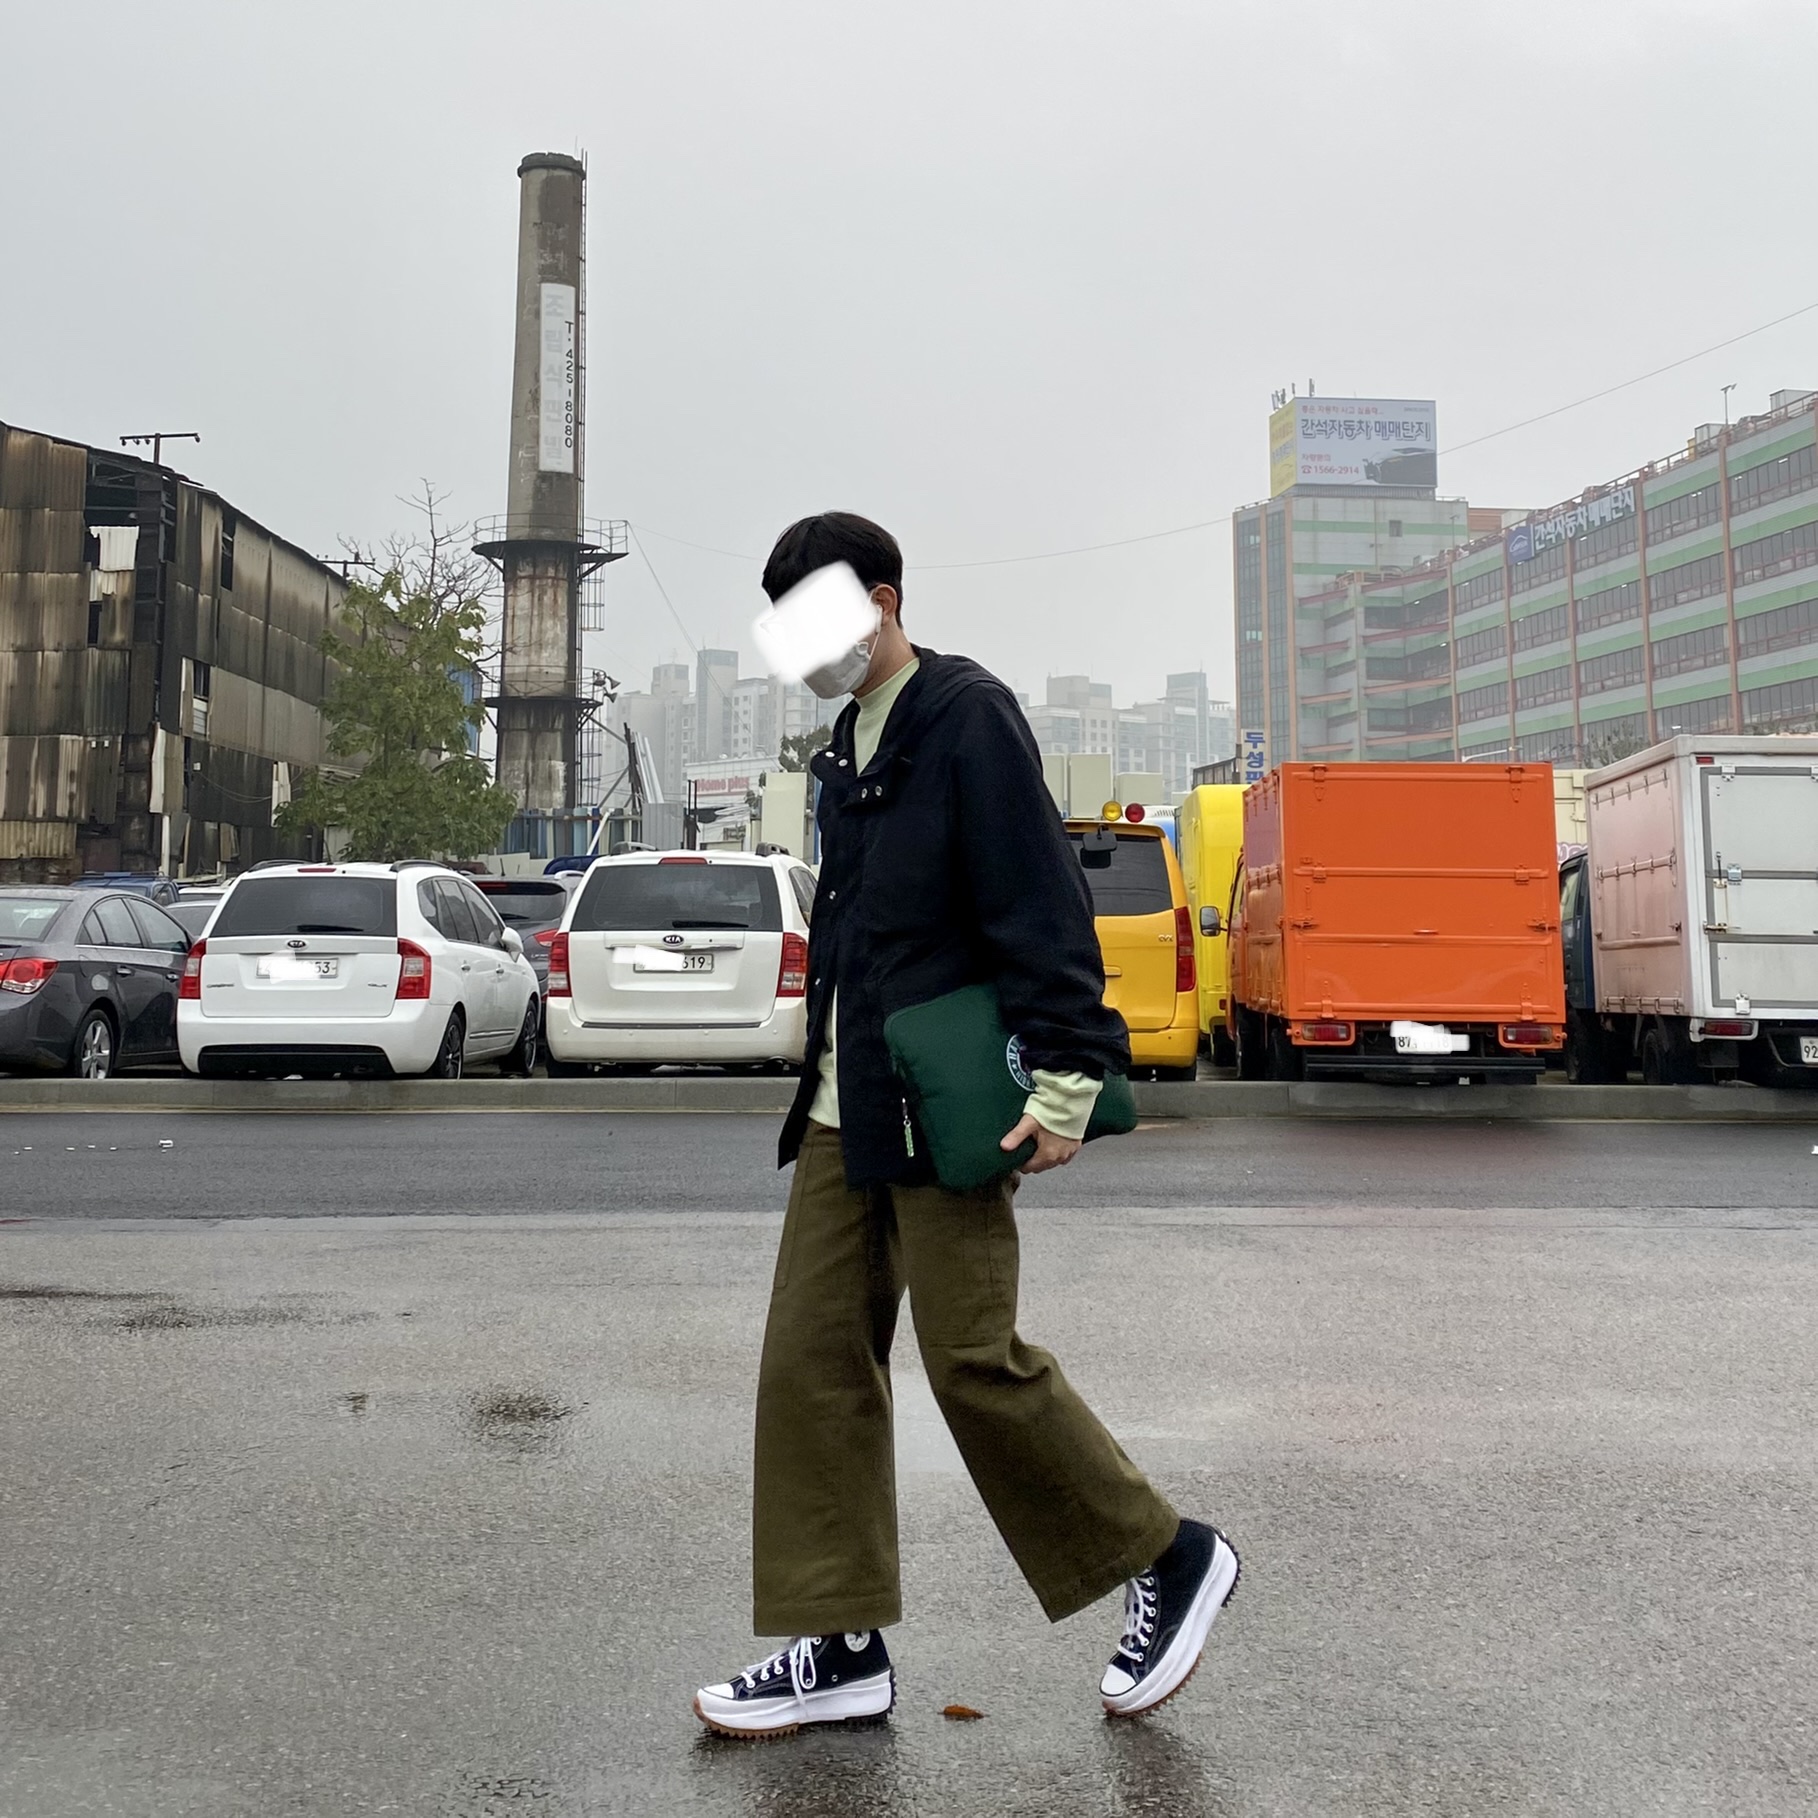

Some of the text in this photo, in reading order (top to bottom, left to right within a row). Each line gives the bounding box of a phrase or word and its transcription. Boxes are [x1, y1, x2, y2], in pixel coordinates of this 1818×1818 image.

[1300, 418, 1371, 440] 간석자동차
[1374, 419, 1431, 441] 매매단지
[1313, 464, 1360, 475] 1566-2914
